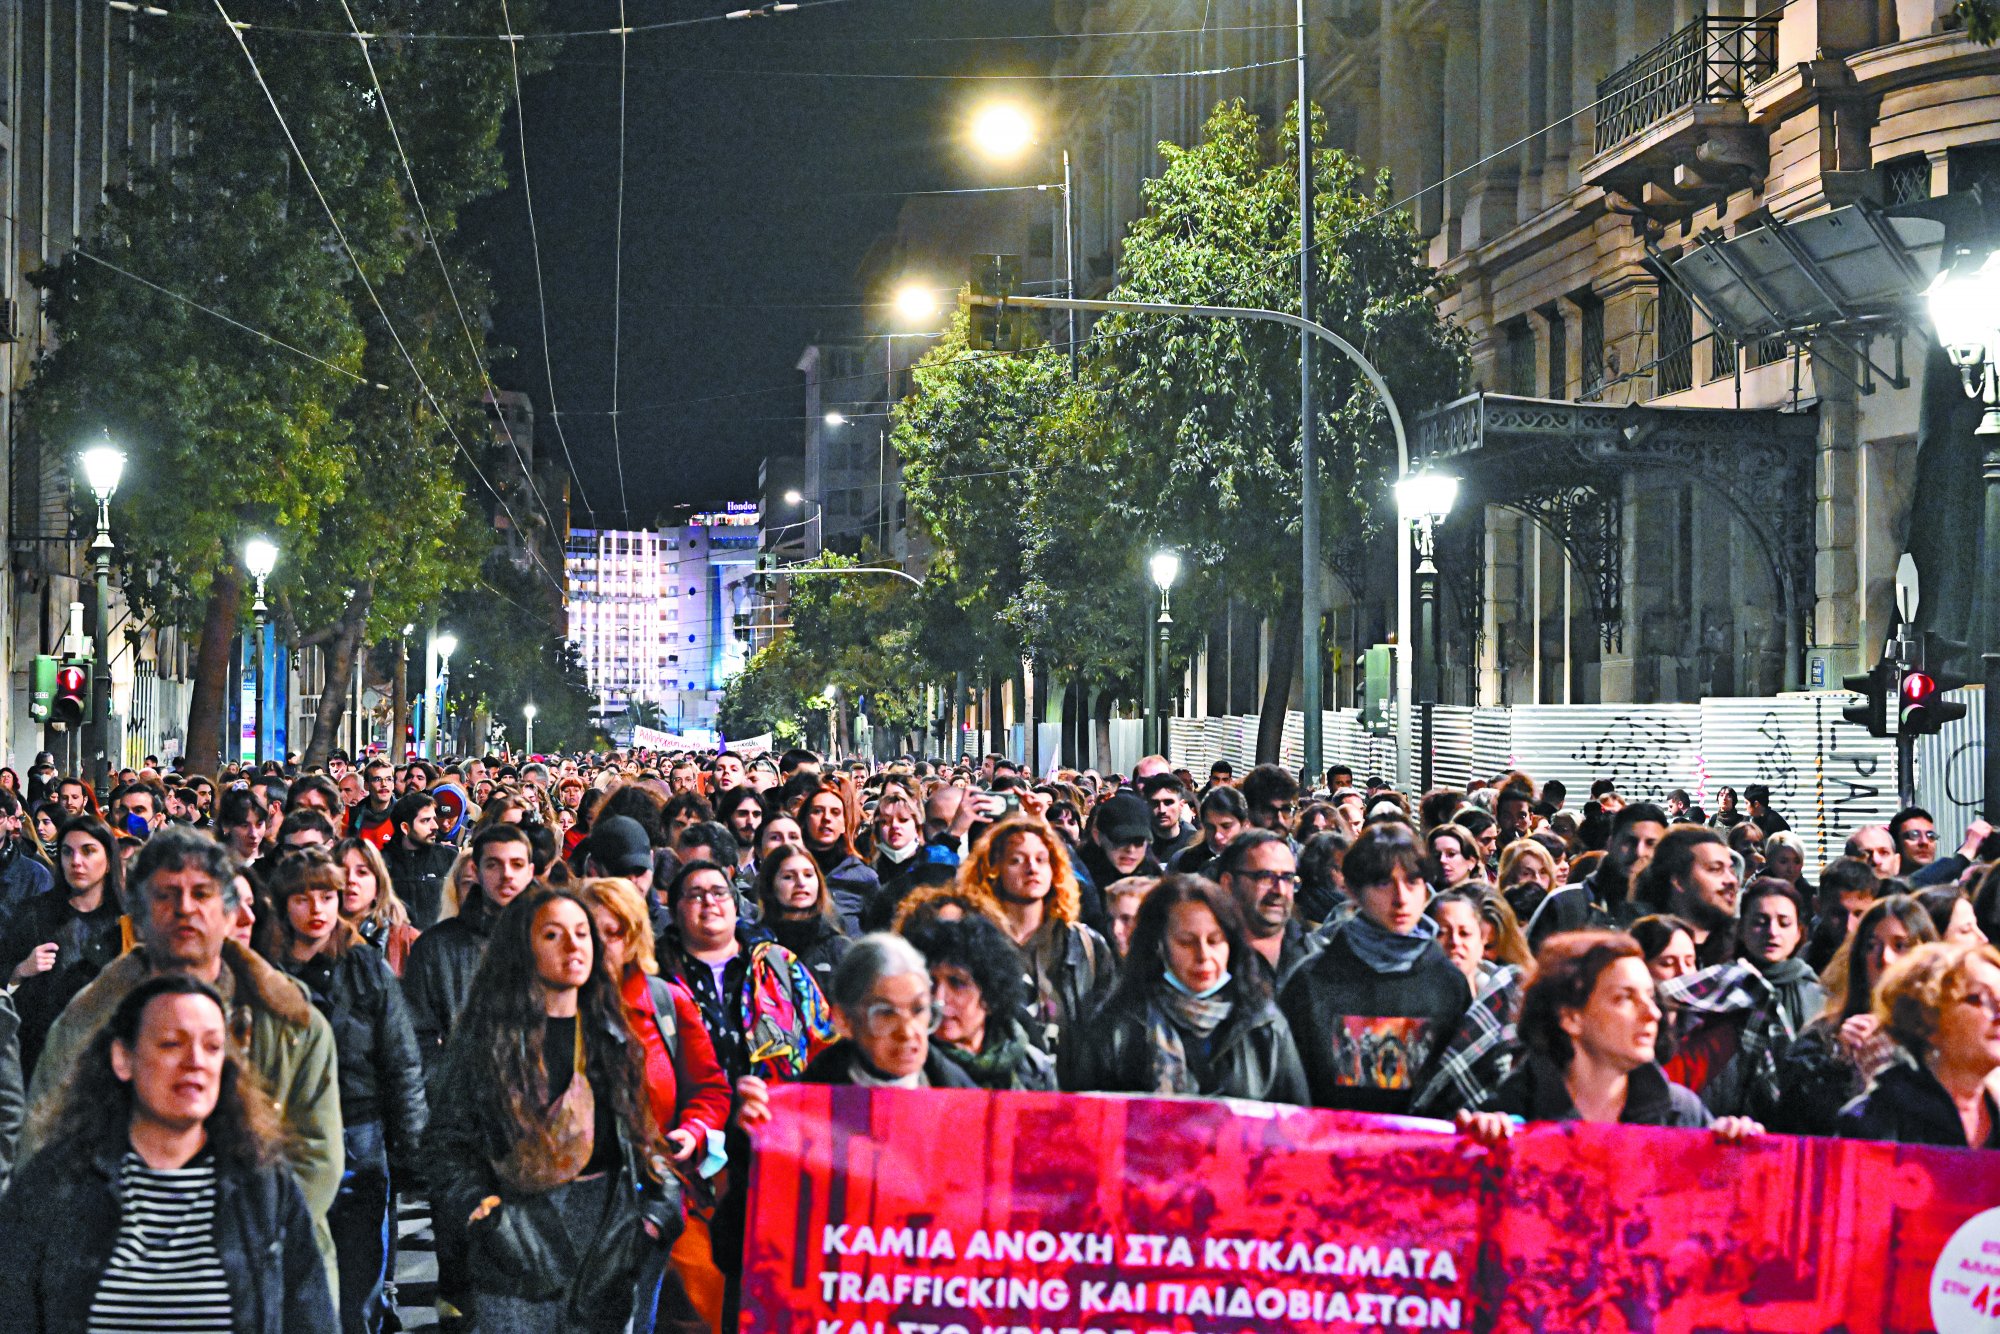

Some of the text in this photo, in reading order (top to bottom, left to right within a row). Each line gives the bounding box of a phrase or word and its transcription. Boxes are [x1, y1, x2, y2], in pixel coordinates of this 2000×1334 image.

[727, 501, 757, 511] Hondos
[823, 1224, 1457, 1281] ΚΑΜΙΑ ΑΝΟΧΗ ΣΤΑ ΚΥΚΛΩΜΑΤΑ
[819, 1271, 1461, 1330] TRAFFICKING ΚΑΙ ΠΑΙΔΟΒΙΑΣΤΩΝ
